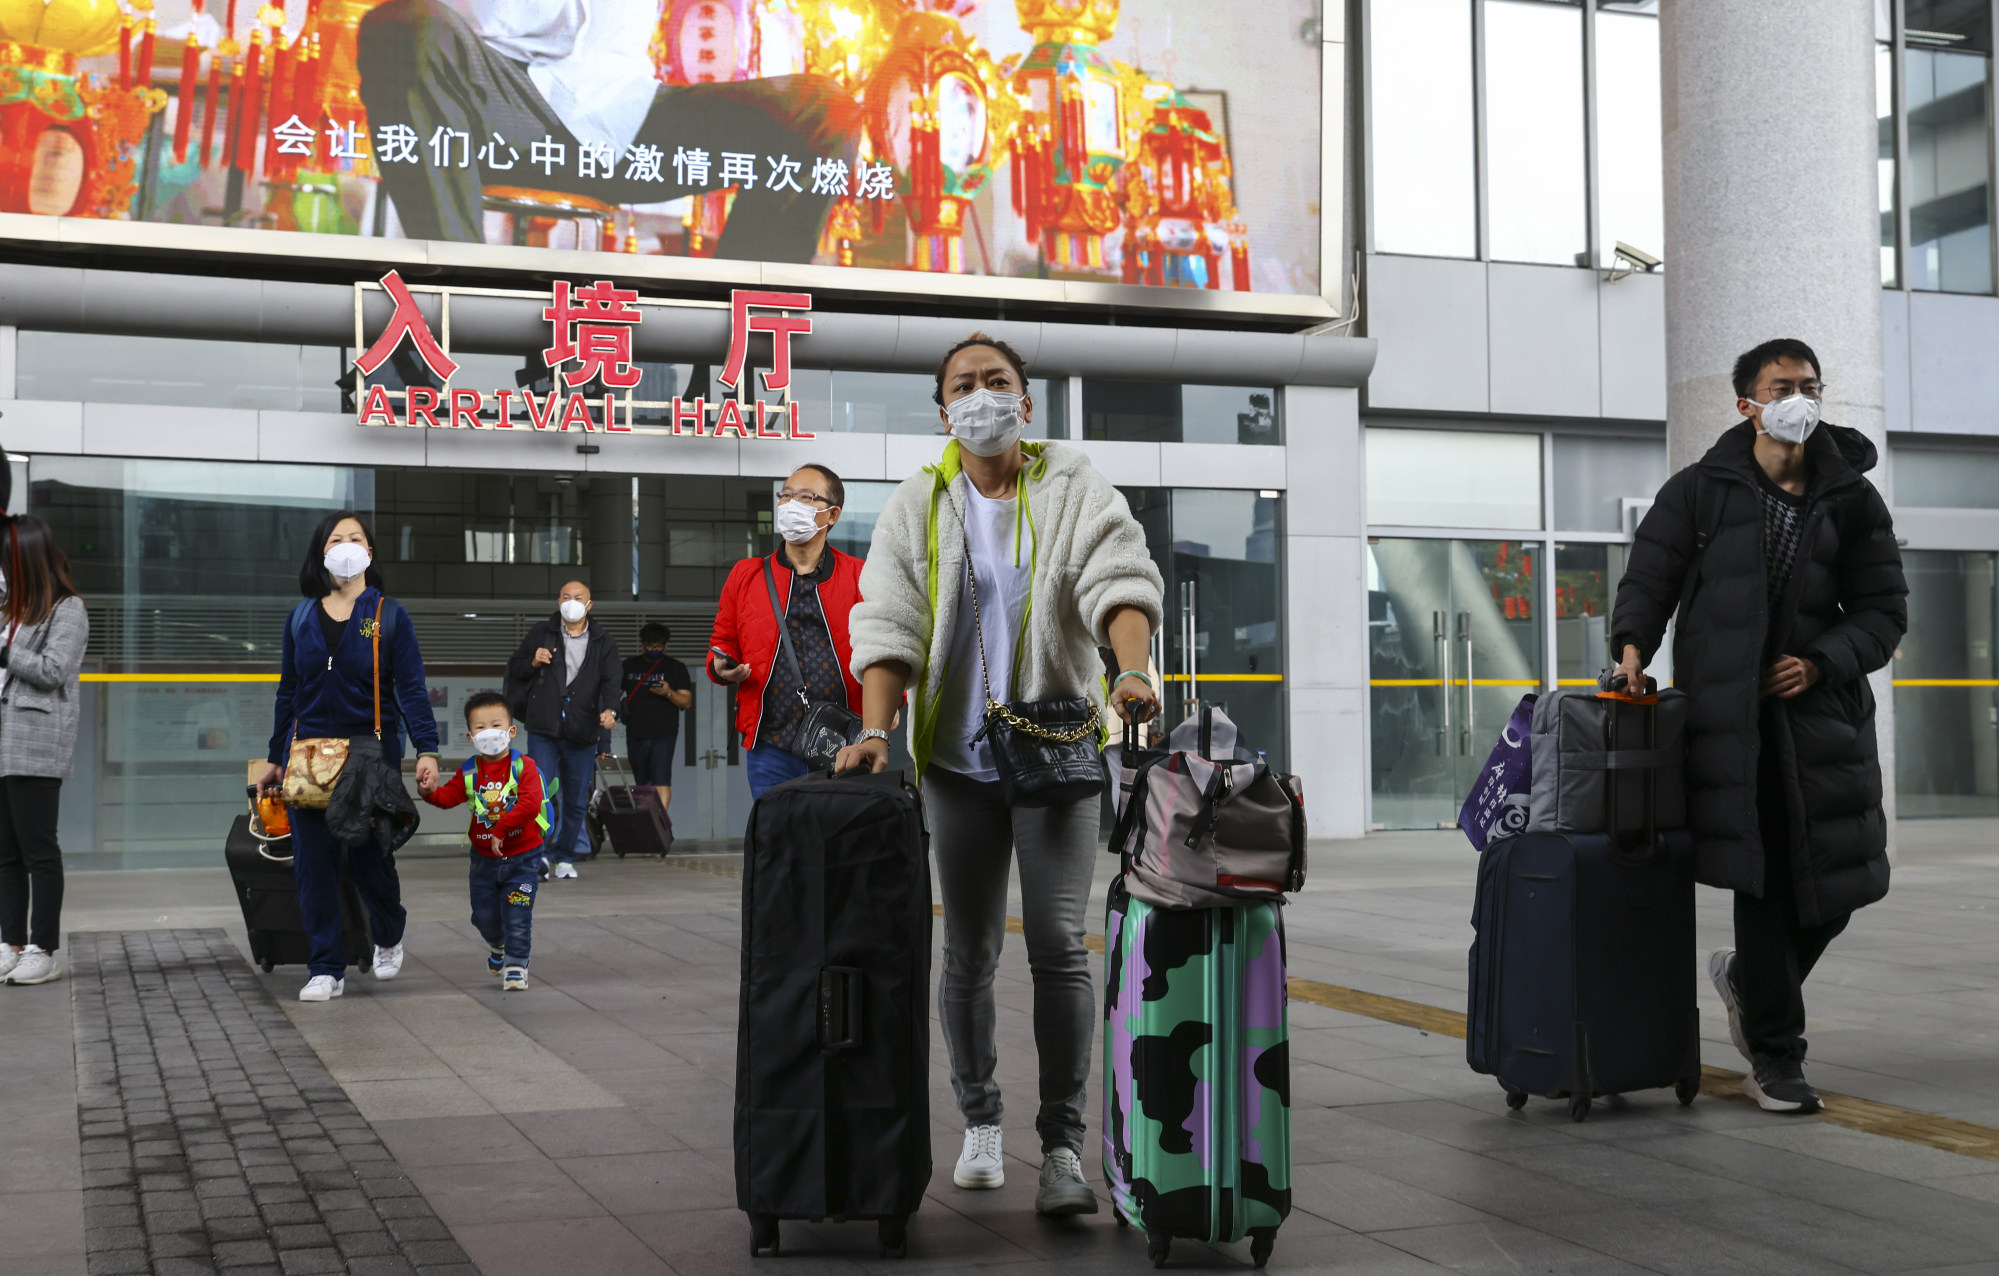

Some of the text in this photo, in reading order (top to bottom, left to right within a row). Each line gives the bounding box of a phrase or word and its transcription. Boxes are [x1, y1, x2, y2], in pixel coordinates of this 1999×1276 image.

[272, 114, 895, 200] 会让我们心中的激情再次燃烧
[352, 269, 812, 391] 入境厅
[358, 384, 816, 439] ARRIVAL HALL
